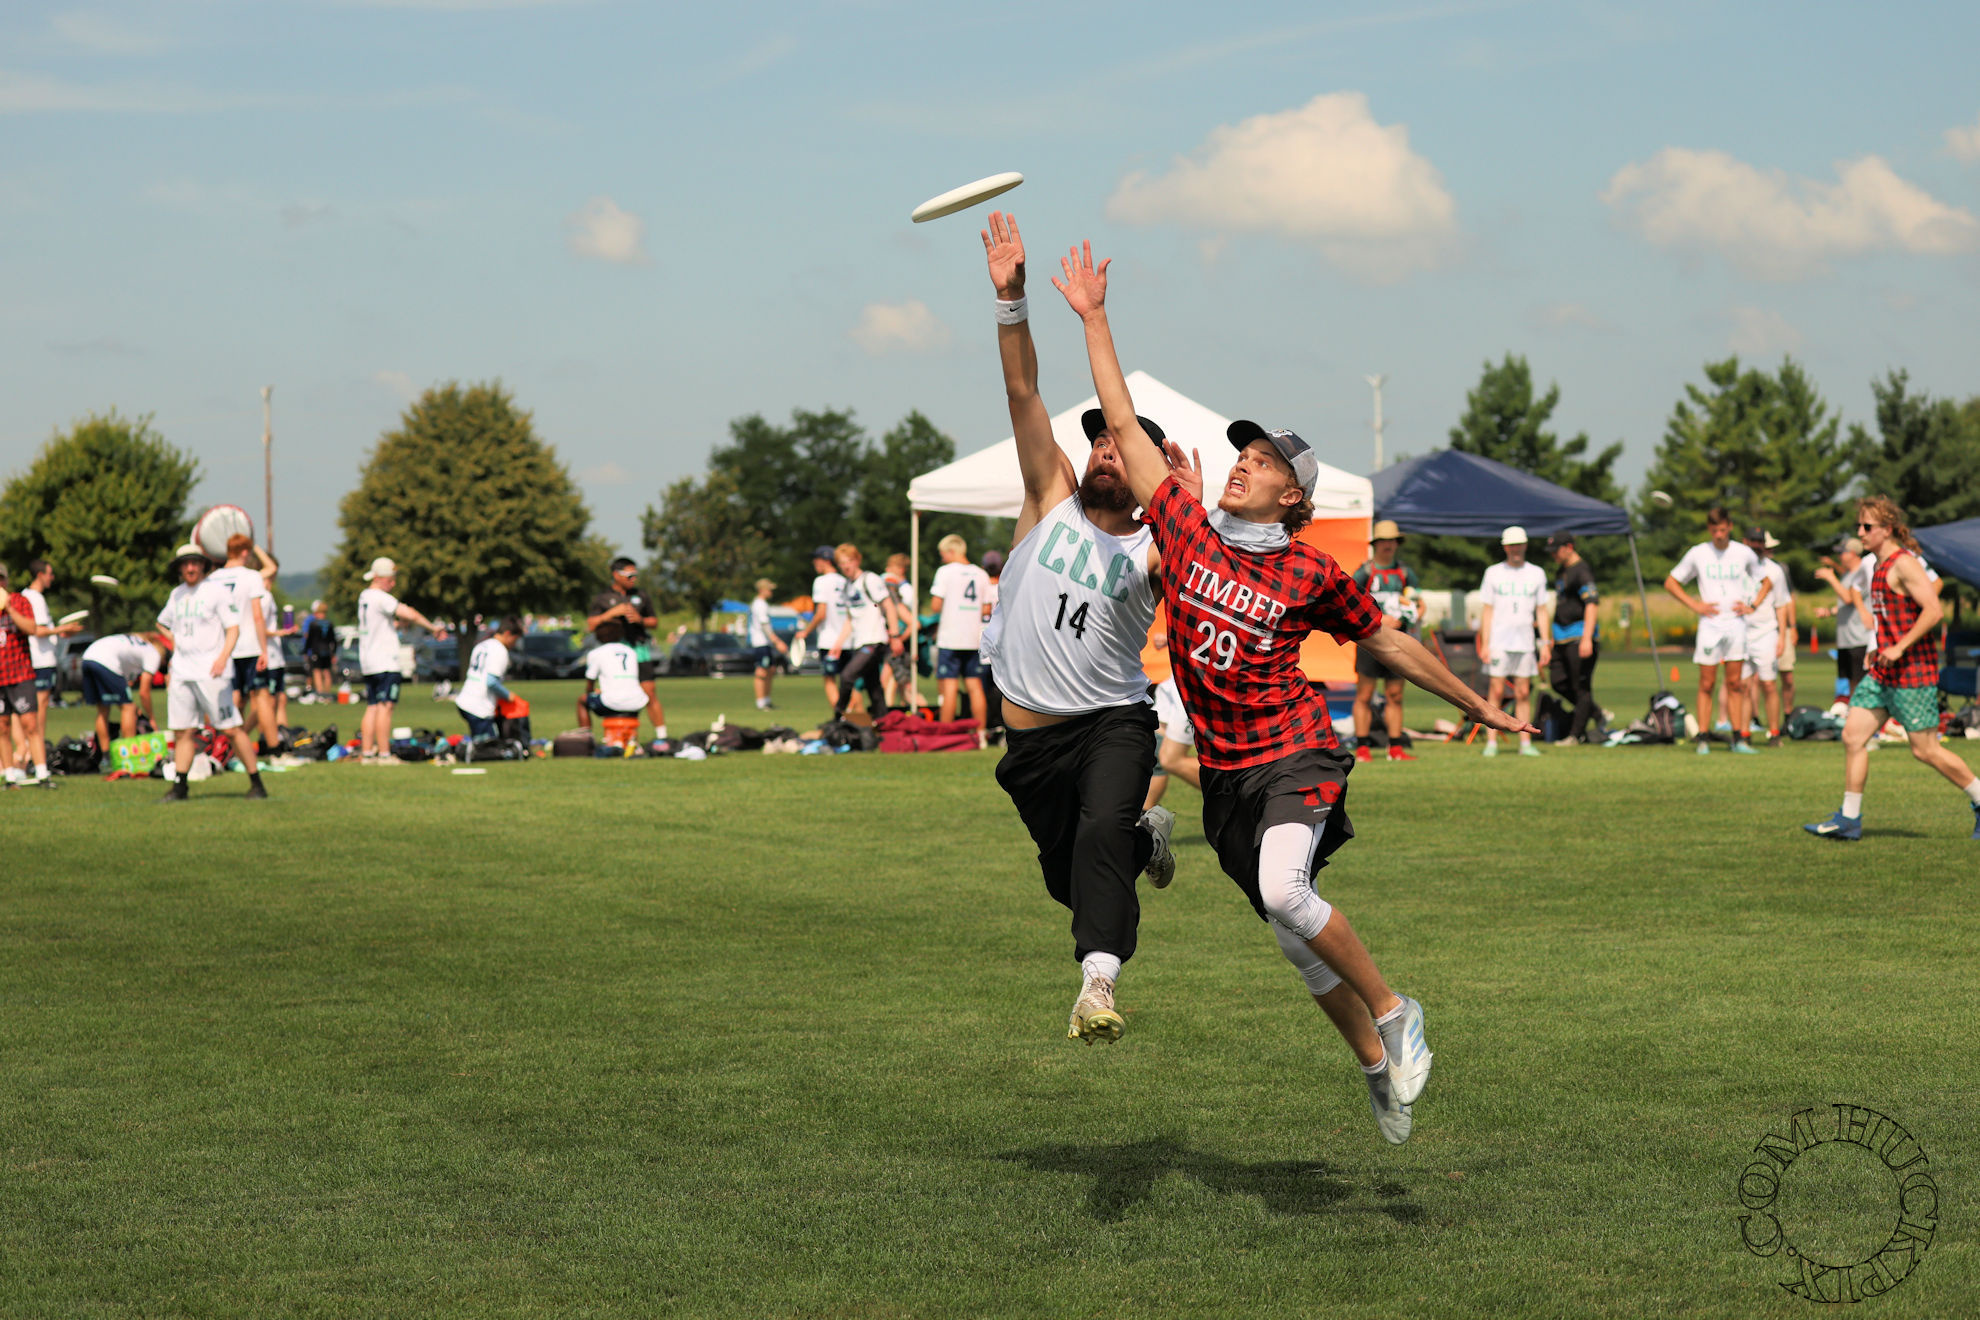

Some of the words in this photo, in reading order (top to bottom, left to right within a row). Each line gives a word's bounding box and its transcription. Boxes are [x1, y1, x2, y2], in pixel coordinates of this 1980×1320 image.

[964, 579, 977, 602] 4
[1184, 560, 1287, 629] TIMBER
[1055, 592, 1089, 639] 14
[615, 652, 627, 672] 7
[1190, 620, 1238, 671] 29
